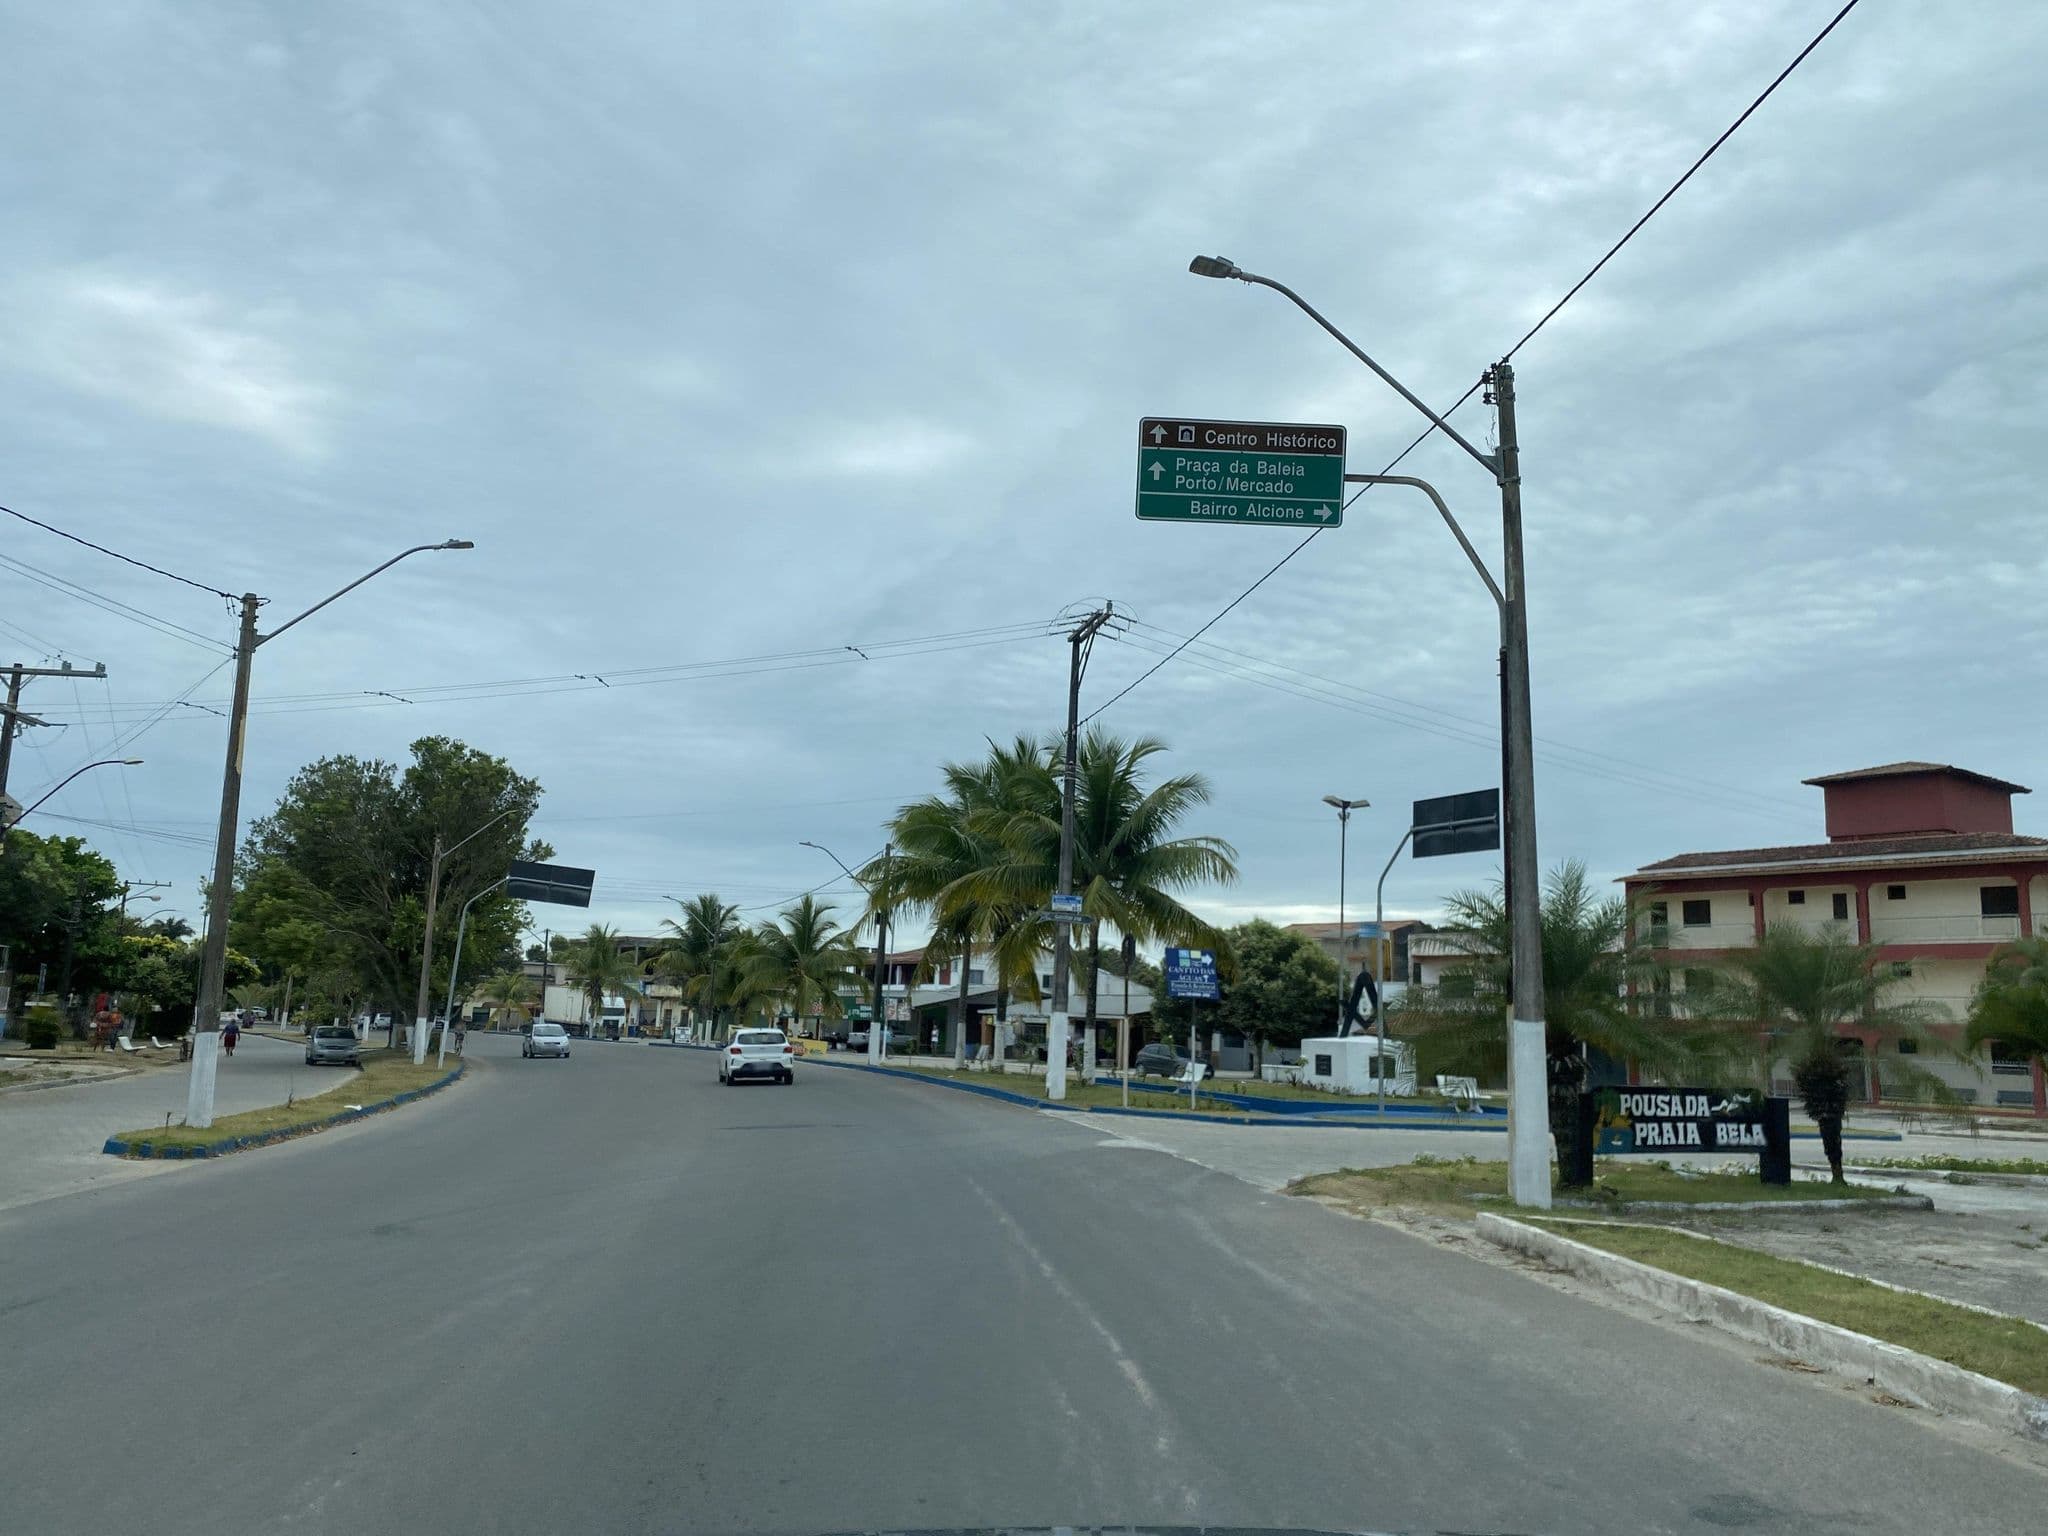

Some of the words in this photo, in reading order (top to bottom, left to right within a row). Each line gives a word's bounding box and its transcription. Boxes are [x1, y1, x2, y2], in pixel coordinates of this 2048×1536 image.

[1205, 429, 1258, 446] Centro
[1266, 432, 1337, 449] Histórico
[1176, 457, 1220, 476] Praça
[1230, 460, 1249, 474] da
[1257, 461, 1305, 477] Baleia
[1175, 475, 1294, 494] Porto/Mercado
[1191, 500, 1238, 516] Bairro
[1246, 503, 1304, 519] Alcione
[1620, 1094, 1711, 1117] POUSADA
[1635, 1122, 1702, 1146] PRAIA
[1715, 1122, 1768, 1146] BELA
